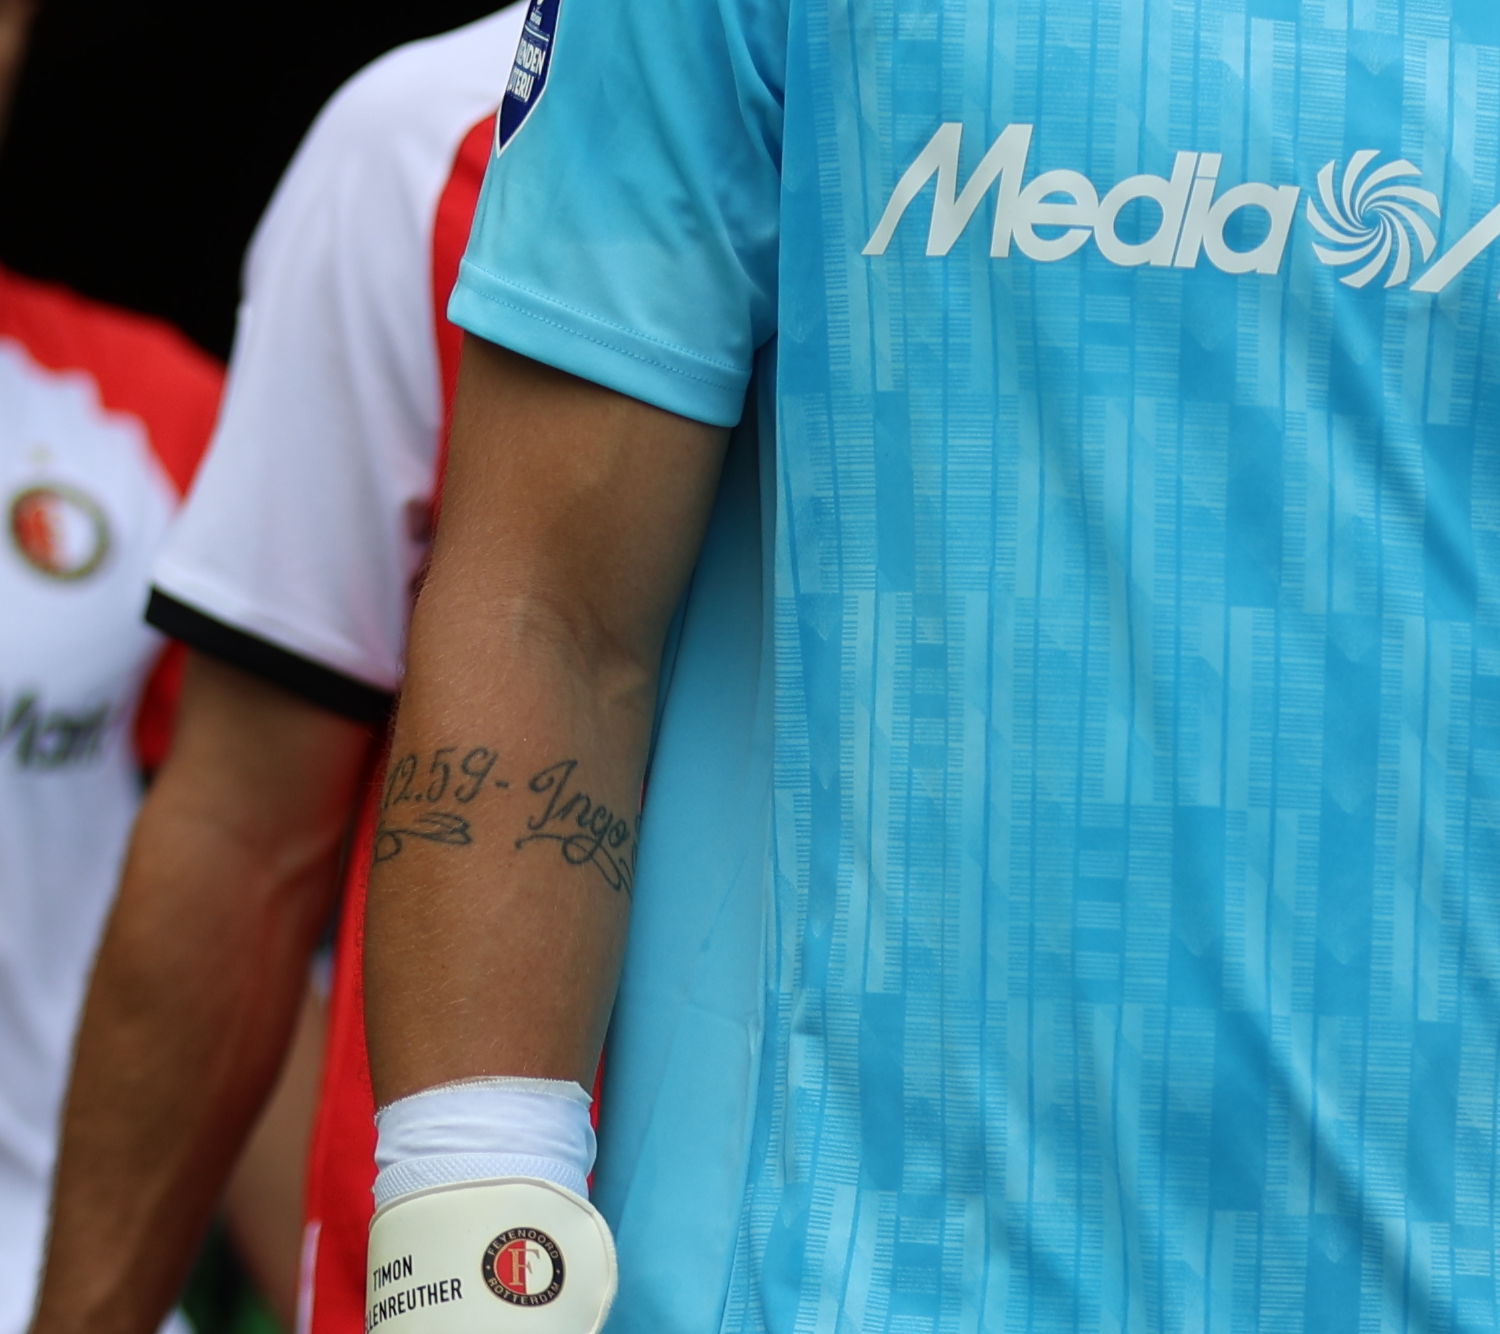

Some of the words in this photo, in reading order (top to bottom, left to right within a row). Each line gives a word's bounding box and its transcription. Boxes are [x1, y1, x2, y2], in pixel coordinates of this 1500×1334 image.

[862, 122, 1299, 275] Media
[488, 1229, 559, 1260] FEYENOORD
[373, 1254, 413, 1292] TIMON
[487, 1277, 560, 1306] ROTTERDAM
